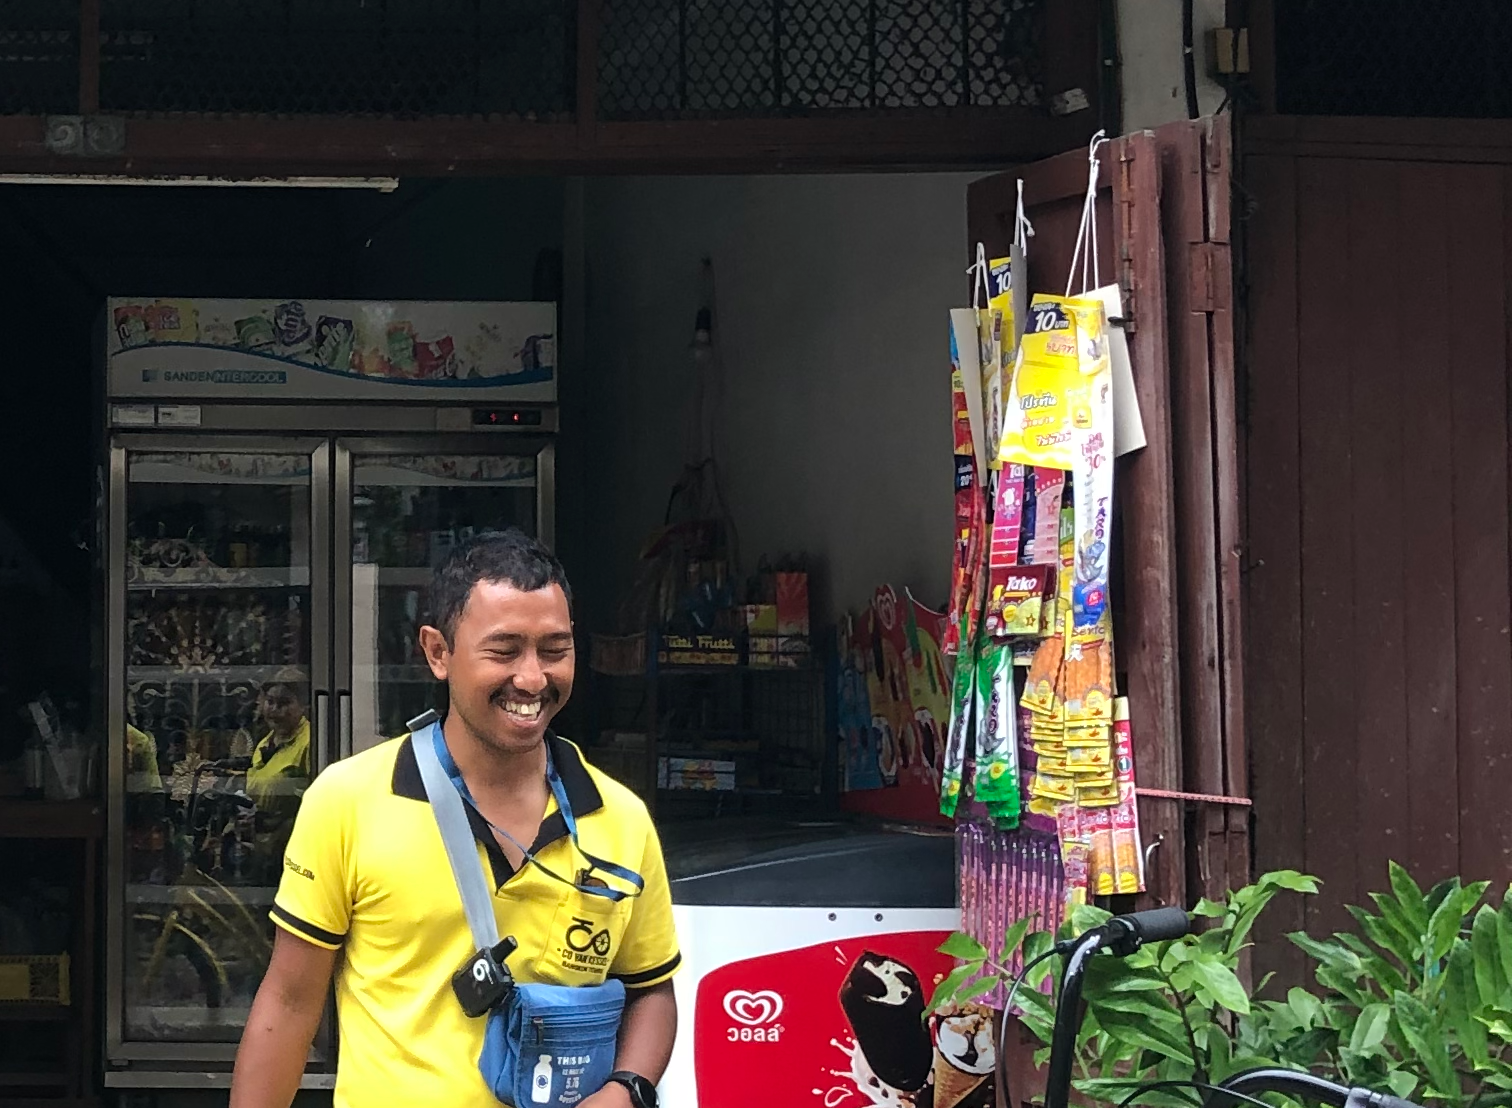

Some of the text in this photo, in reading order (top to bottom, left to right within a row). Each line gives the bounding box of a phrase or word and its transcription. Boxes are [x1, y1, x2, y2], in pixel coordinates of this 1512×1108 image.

[1035, 311, 1057, 333] 10
[163, 370, 215, 383] SANDEN
[1095, 496, 1108, 540] TARO
[1006, 576, 1037, 591] Tako
[662, 635, 736, 650] Tutti Frutti
[727, 1022, 781, 1043] วอลล์
[557, 1056, 577, 1065] THIS
